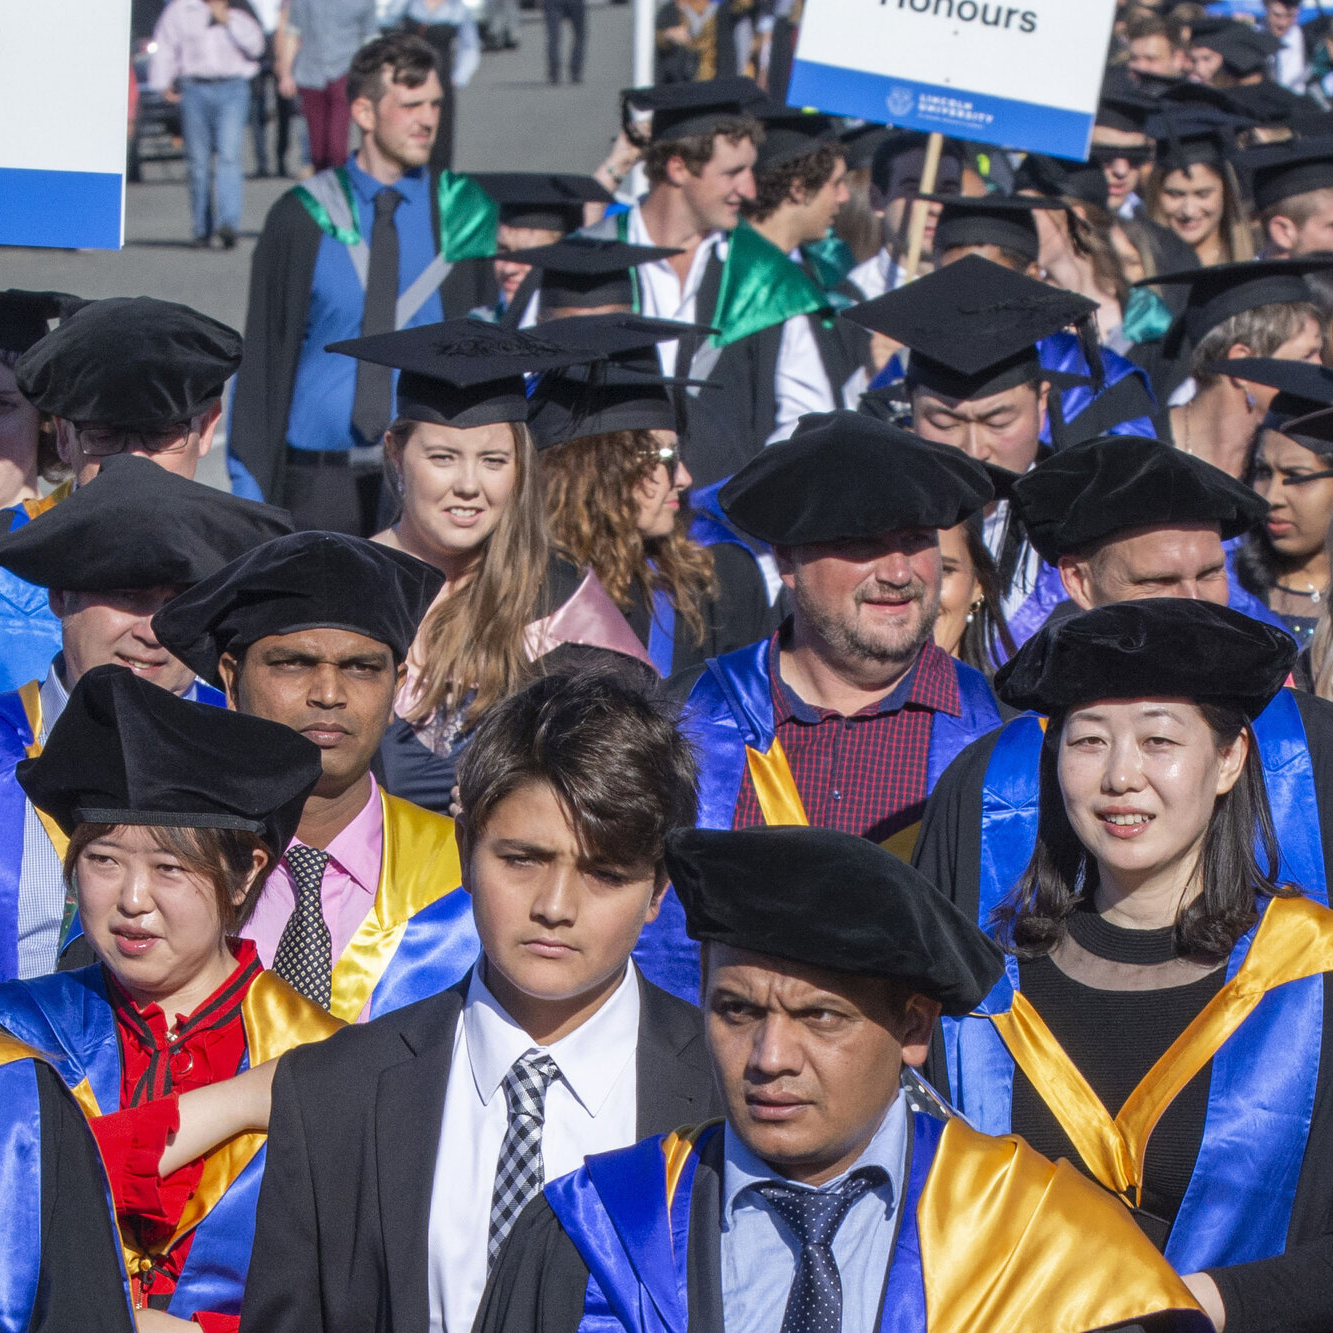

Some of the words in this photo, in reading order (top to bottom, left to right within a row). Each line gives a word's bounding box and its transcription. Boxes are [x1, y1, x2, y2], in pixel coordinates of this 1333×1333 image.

[880, 0, 1038, 33] onours
[918, 94, 973, 110] LINCOLN
[918, 103, 994, 124] UNIVERSITY
